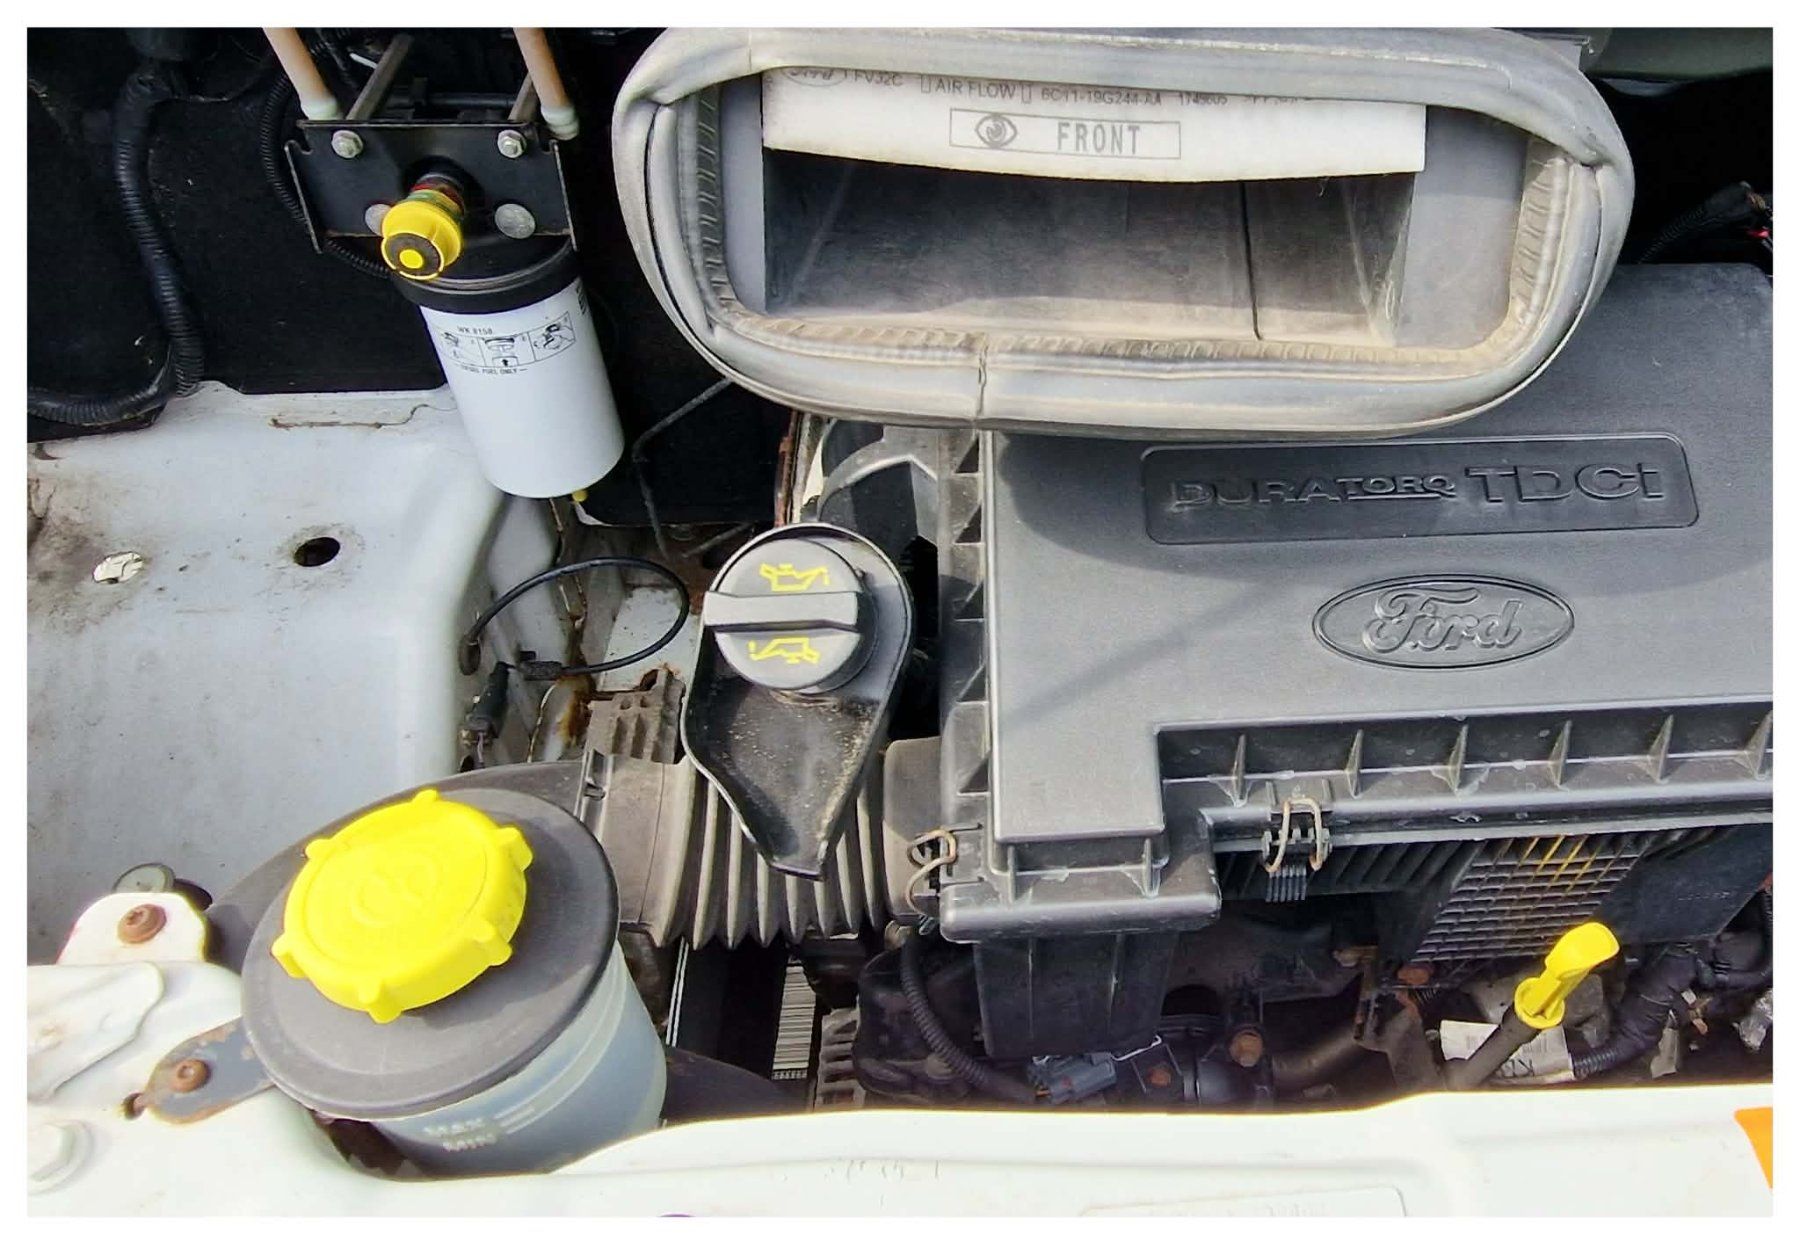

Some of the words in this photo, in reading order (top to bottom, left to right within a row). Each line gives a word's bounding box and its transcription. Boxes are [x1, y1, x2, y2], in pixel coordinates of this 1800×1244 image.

[935, 77, 963, 95] AIR
[968, 81, 1017, 100] FLOW
[1057, 121, 1141, 155] FRONT
[482, 367, 498, 376] FUEL
[500, 367, 517, 375] ONLY
[1360, 585, 1523, 655] Ford
